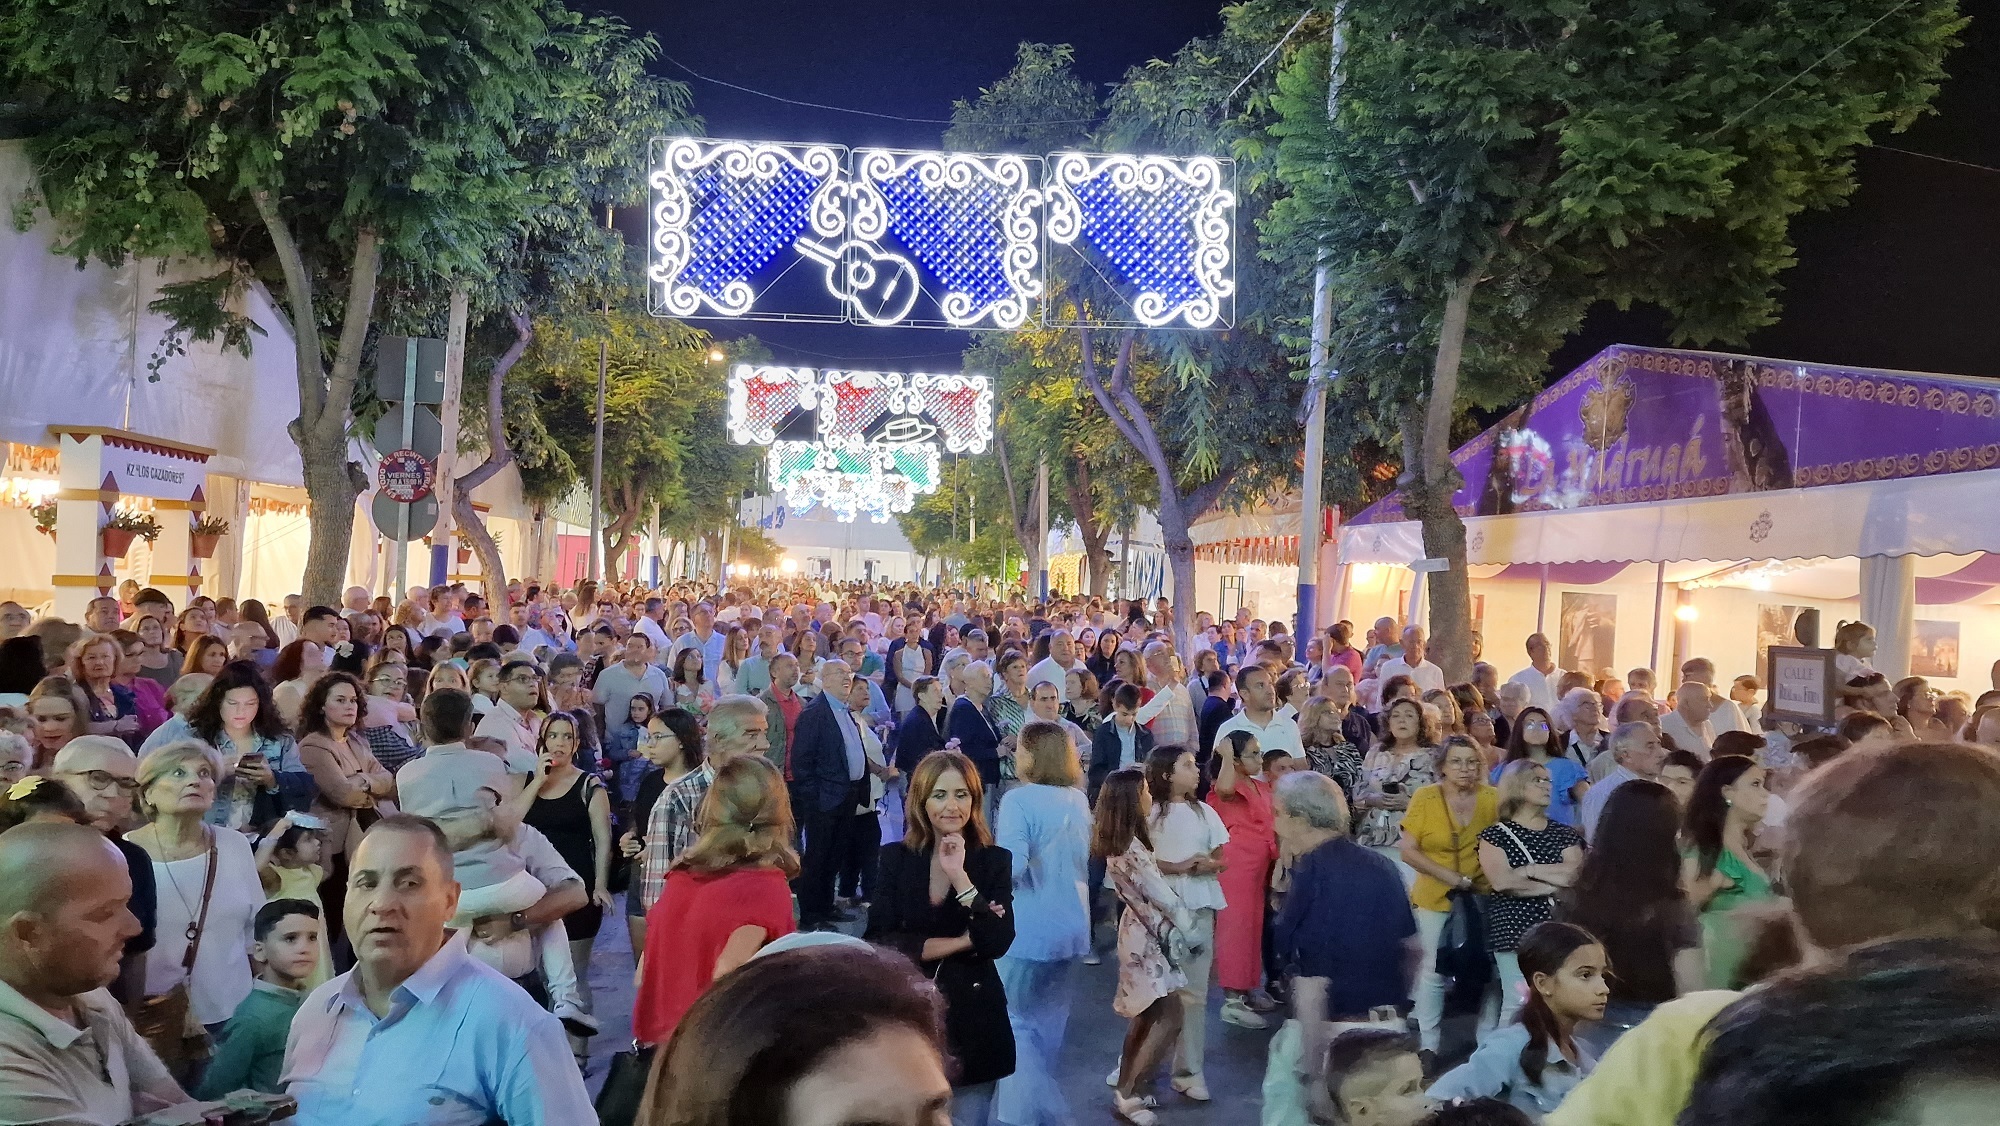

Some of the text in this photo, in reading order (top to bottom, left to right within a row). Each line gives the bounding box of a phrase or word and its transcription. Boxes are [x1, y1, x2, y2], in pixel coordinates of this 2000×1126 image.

[126, 463, 135, 477] KZ
[379, 450, 431, 499] EN TODO EL RECINTO FERIAL
[1784, 667, 1814, 681] CALLE
